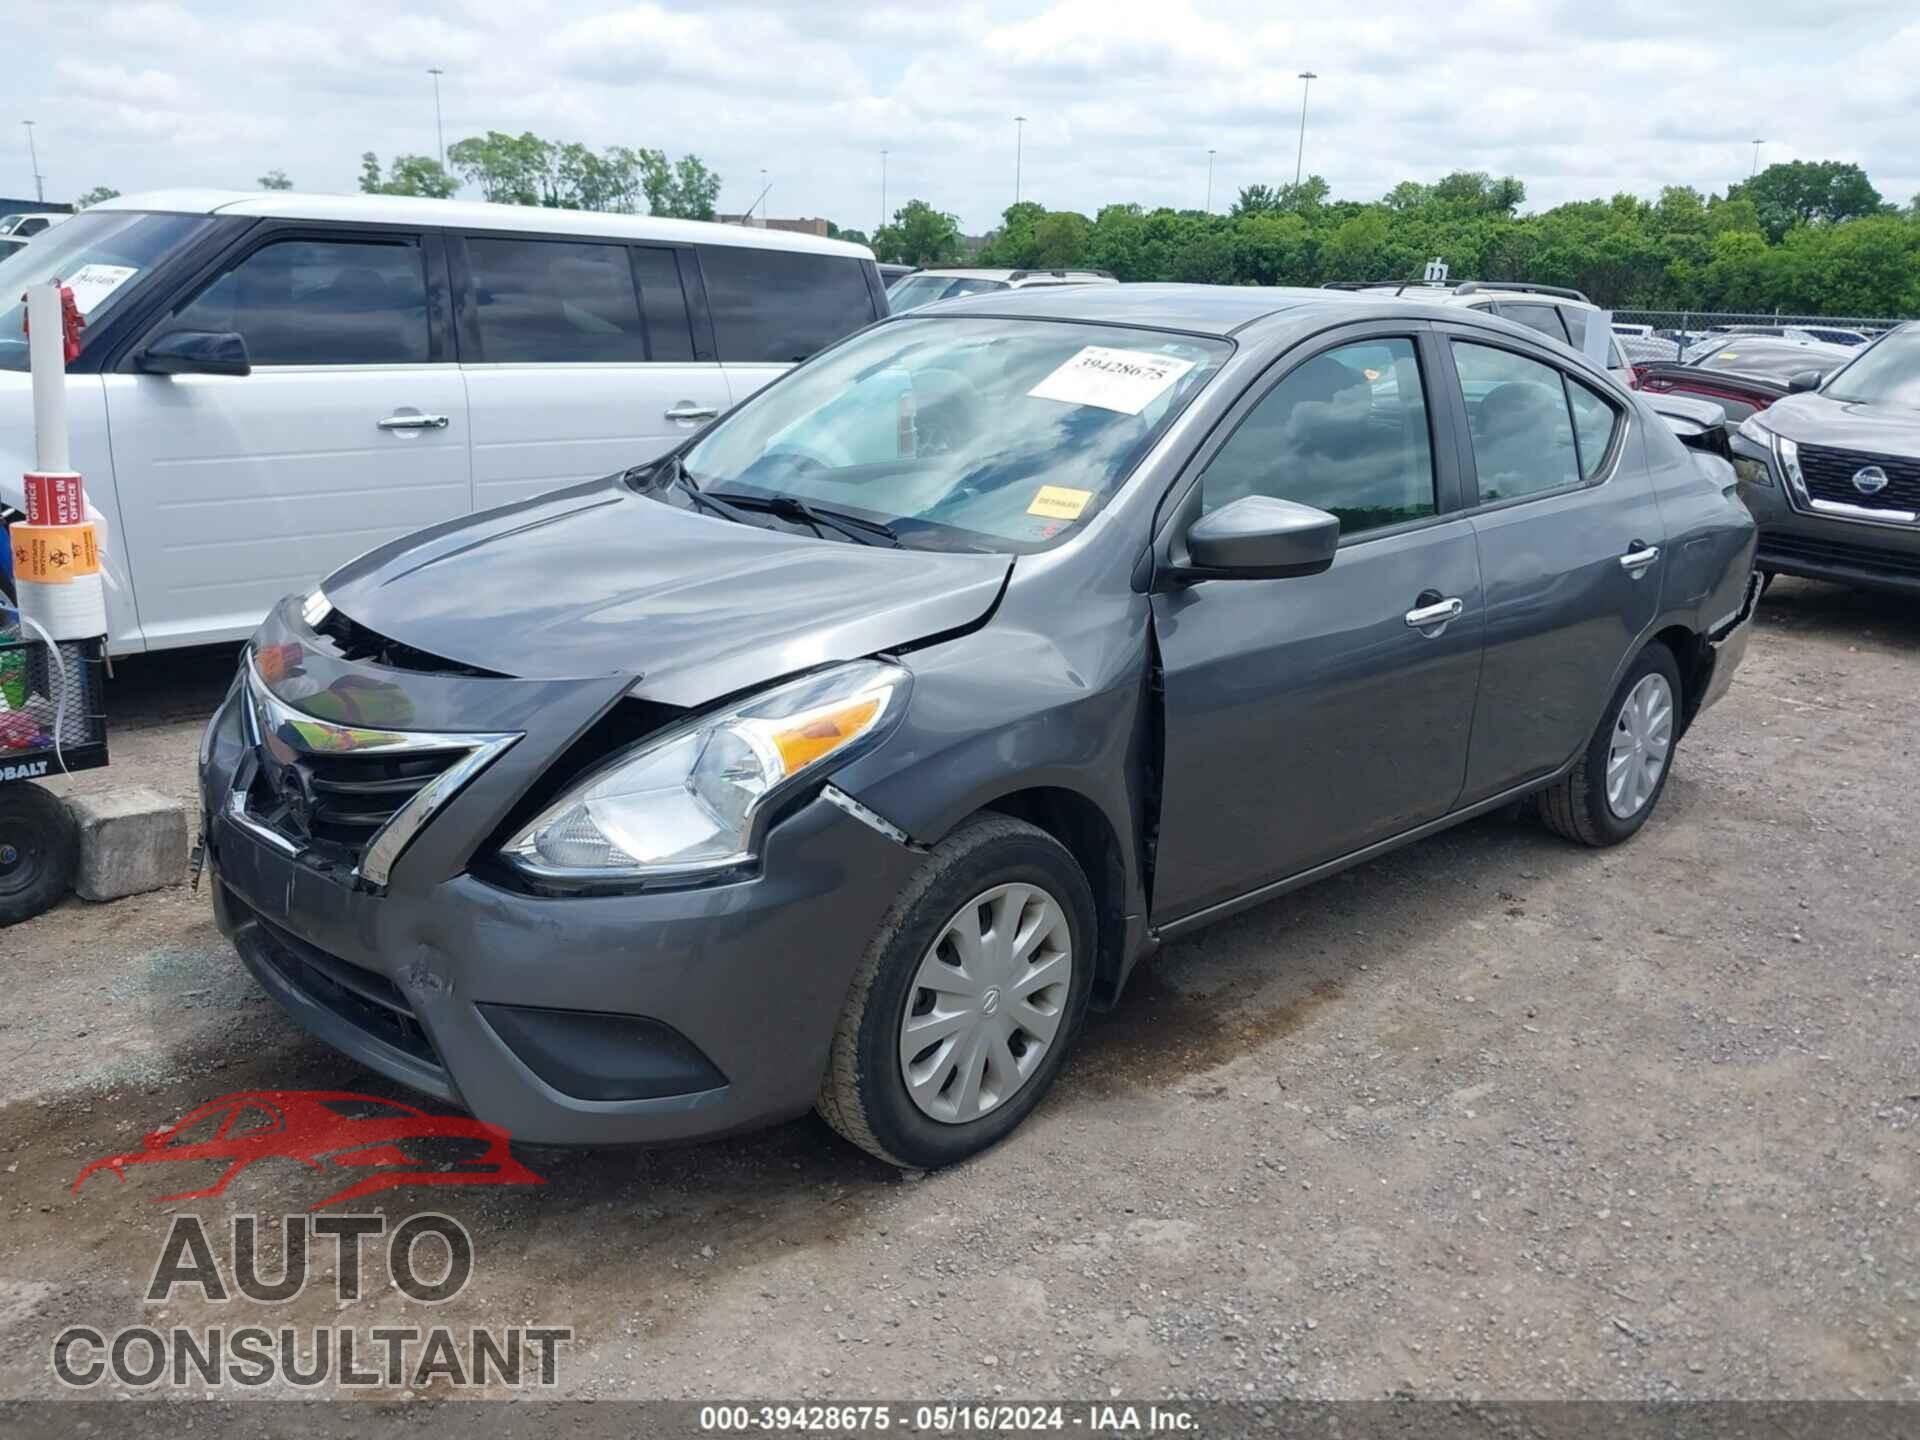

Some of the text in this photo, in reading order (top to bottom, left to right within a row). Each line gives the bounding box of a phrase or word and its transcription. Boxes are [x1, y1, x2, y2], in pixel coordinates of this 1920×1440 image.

[28, 483, 39, 520] OFFICE
[56, 480, 68, 523] KEYS IN
[68, 483, 78, 520] OFFICE
